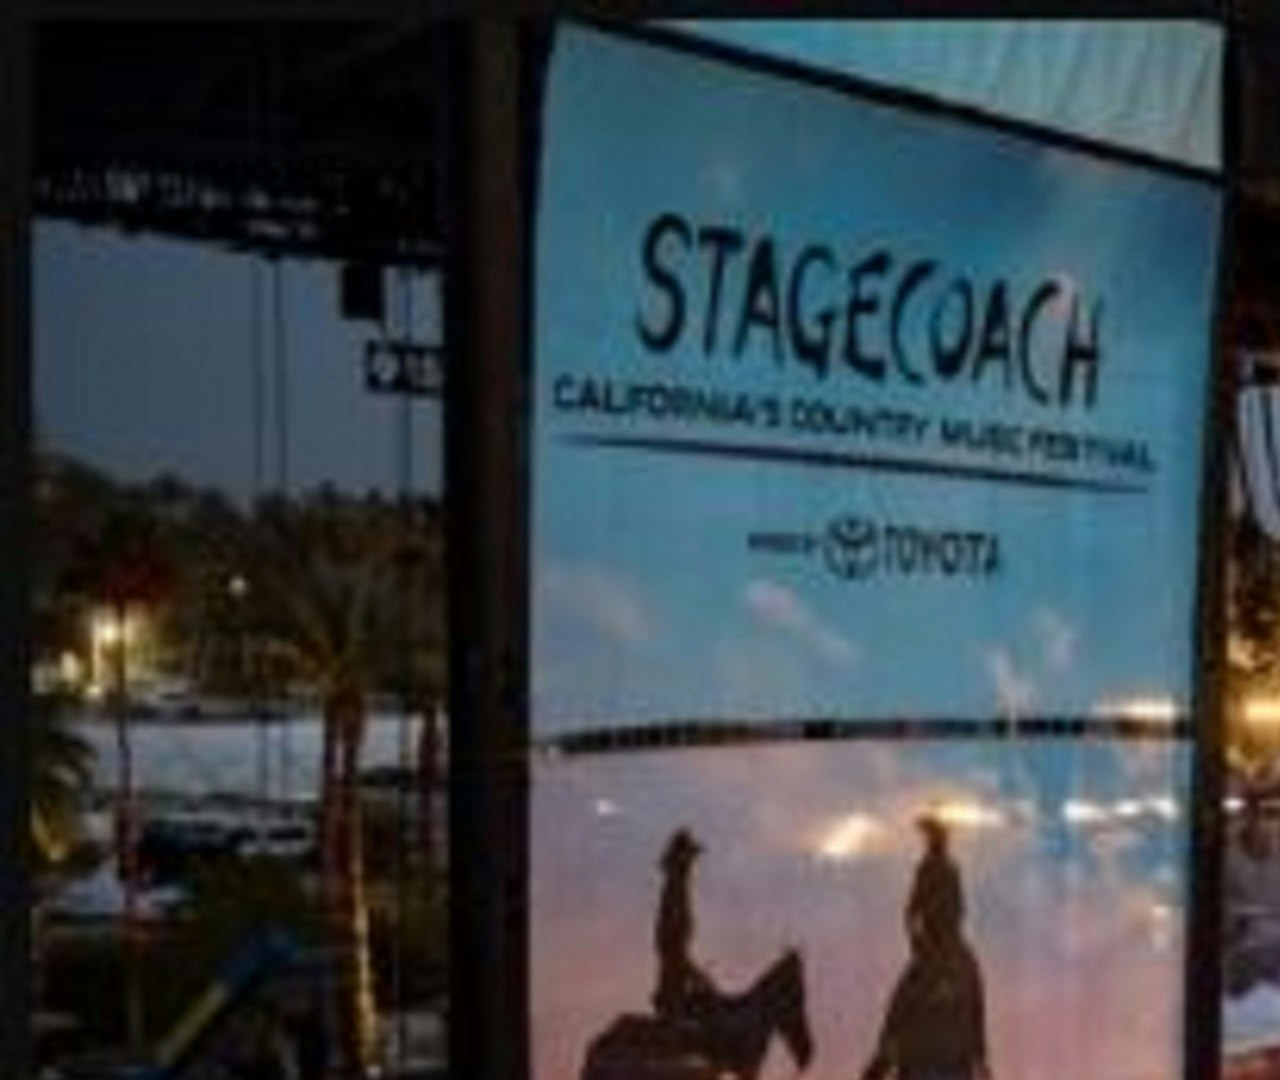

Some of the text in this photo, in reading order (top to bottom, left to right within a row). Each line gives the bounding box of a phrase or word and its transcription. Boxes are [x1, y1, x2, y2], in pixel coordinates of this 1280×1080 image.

[638, 213, 1104, 409] STAGECOACH
[553, 375, 1157, 474] CALIFORNIA'S COUNTRY MUSIC FESTIVAL
[884, 525, 1000, 577] TOYOTA
